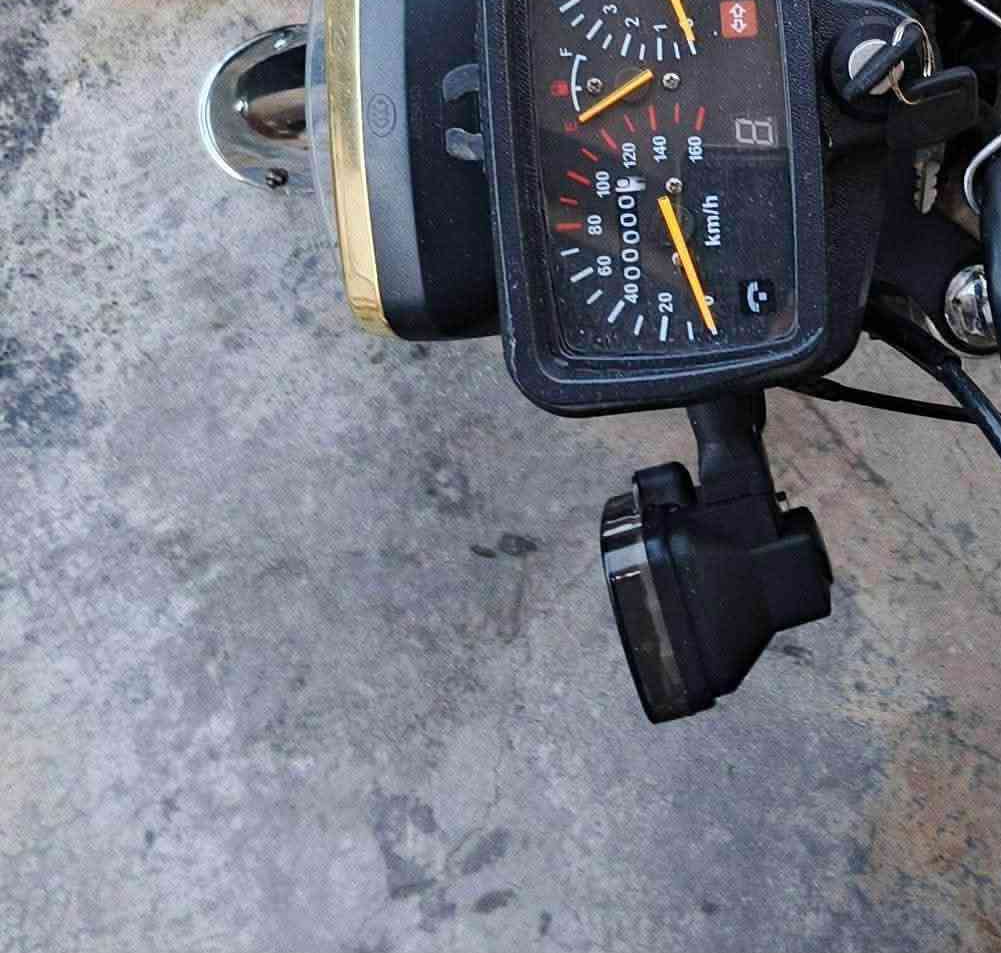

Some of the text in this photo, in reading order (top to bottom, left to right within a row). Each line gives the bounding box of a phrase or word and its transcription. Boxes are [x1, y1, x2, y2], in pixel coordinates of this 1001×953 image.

[603, 4, 618, 14] 3
[625, 16, 640, 27] 2
[654, 23, 667, 31] 1
[560, 48, 572, 57] F
[622, 143, 637, 168] 120
[653, 136, 667, 162] 140
[688, 136, 703, 162] 160
[596, 171, 611, 197] 100
[587, 215, 602, 235] 80
[702, 195, 721, 247] km/h
[597, 256, 612, 276] 60
[624, 283, 639, 304] 40
[658, 292, 673, 313] 20
